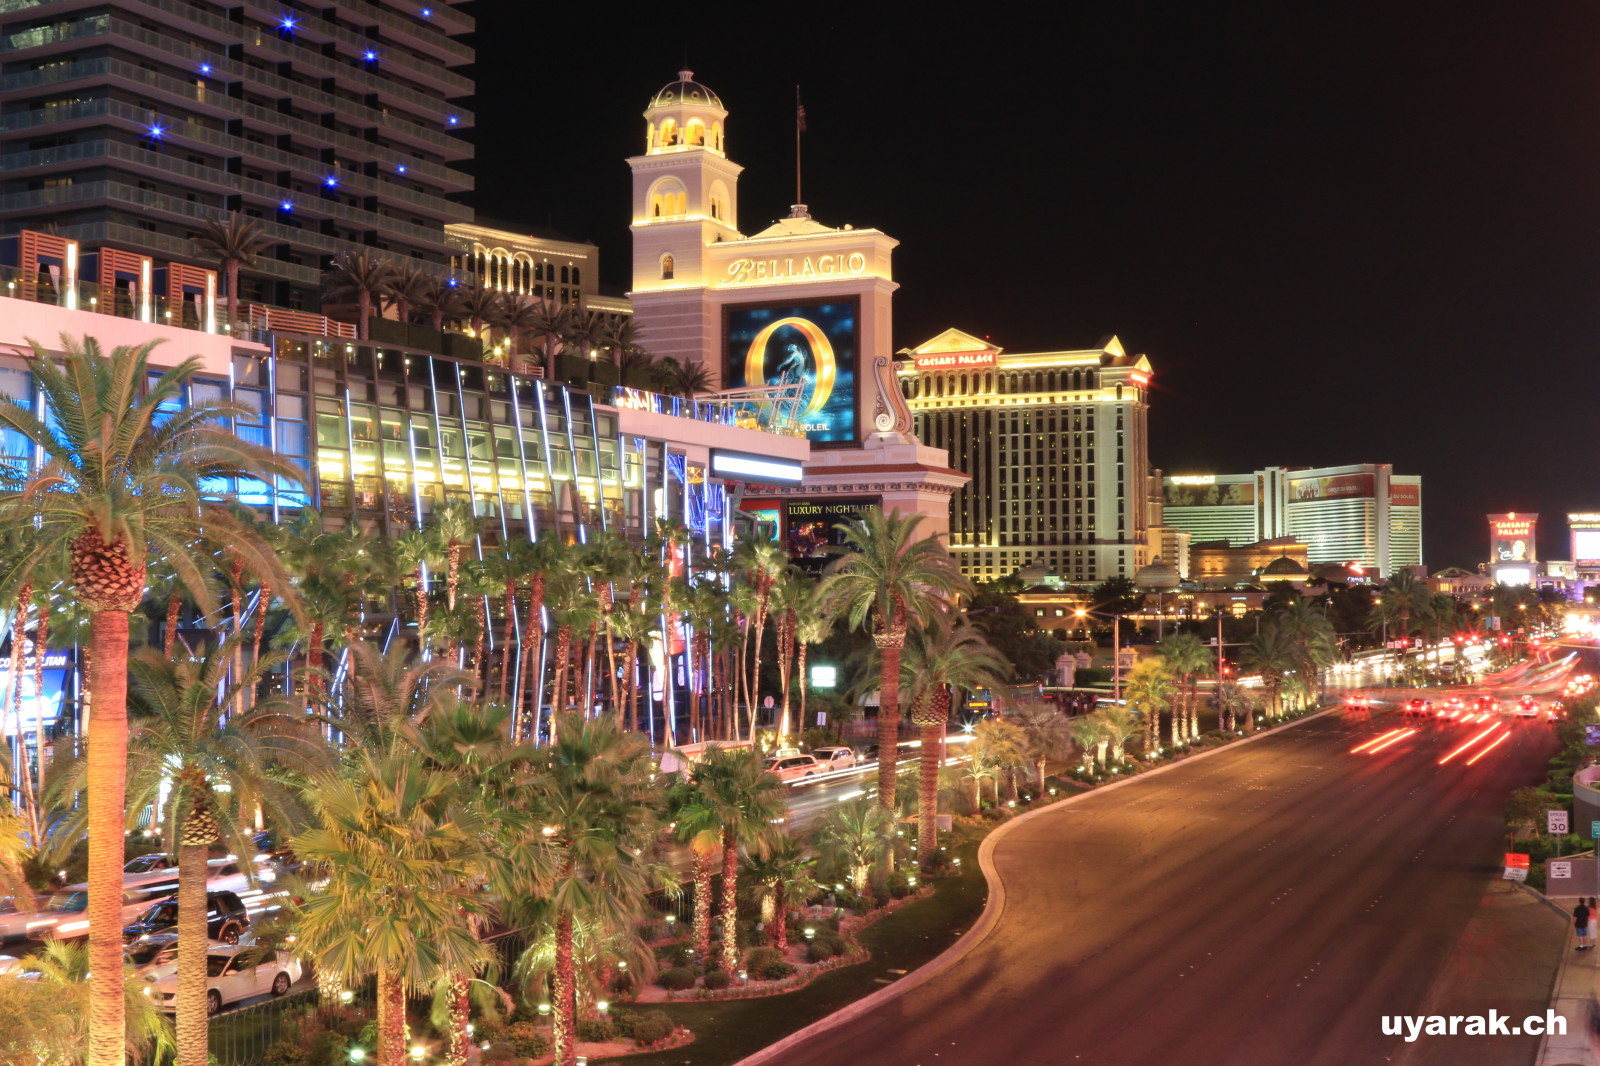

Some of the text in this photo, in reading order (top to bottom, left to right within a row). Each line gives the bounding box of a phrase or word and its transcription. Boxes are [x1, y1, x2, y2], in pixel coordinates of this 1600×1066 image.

[723, 252, 866, 283] BELLAGIO
[918, 354, 993, 366] CAESARS PALACE
[800, 423, 830, 432] SOLEIL
[788, 504, 874, 515] LUXURY NIGHTLIFE
[1496, 521, 1531, 529] CAESARS
[1498, 528, 1529, 536] PALACE
[1551, 823, 1566, 831] 30
